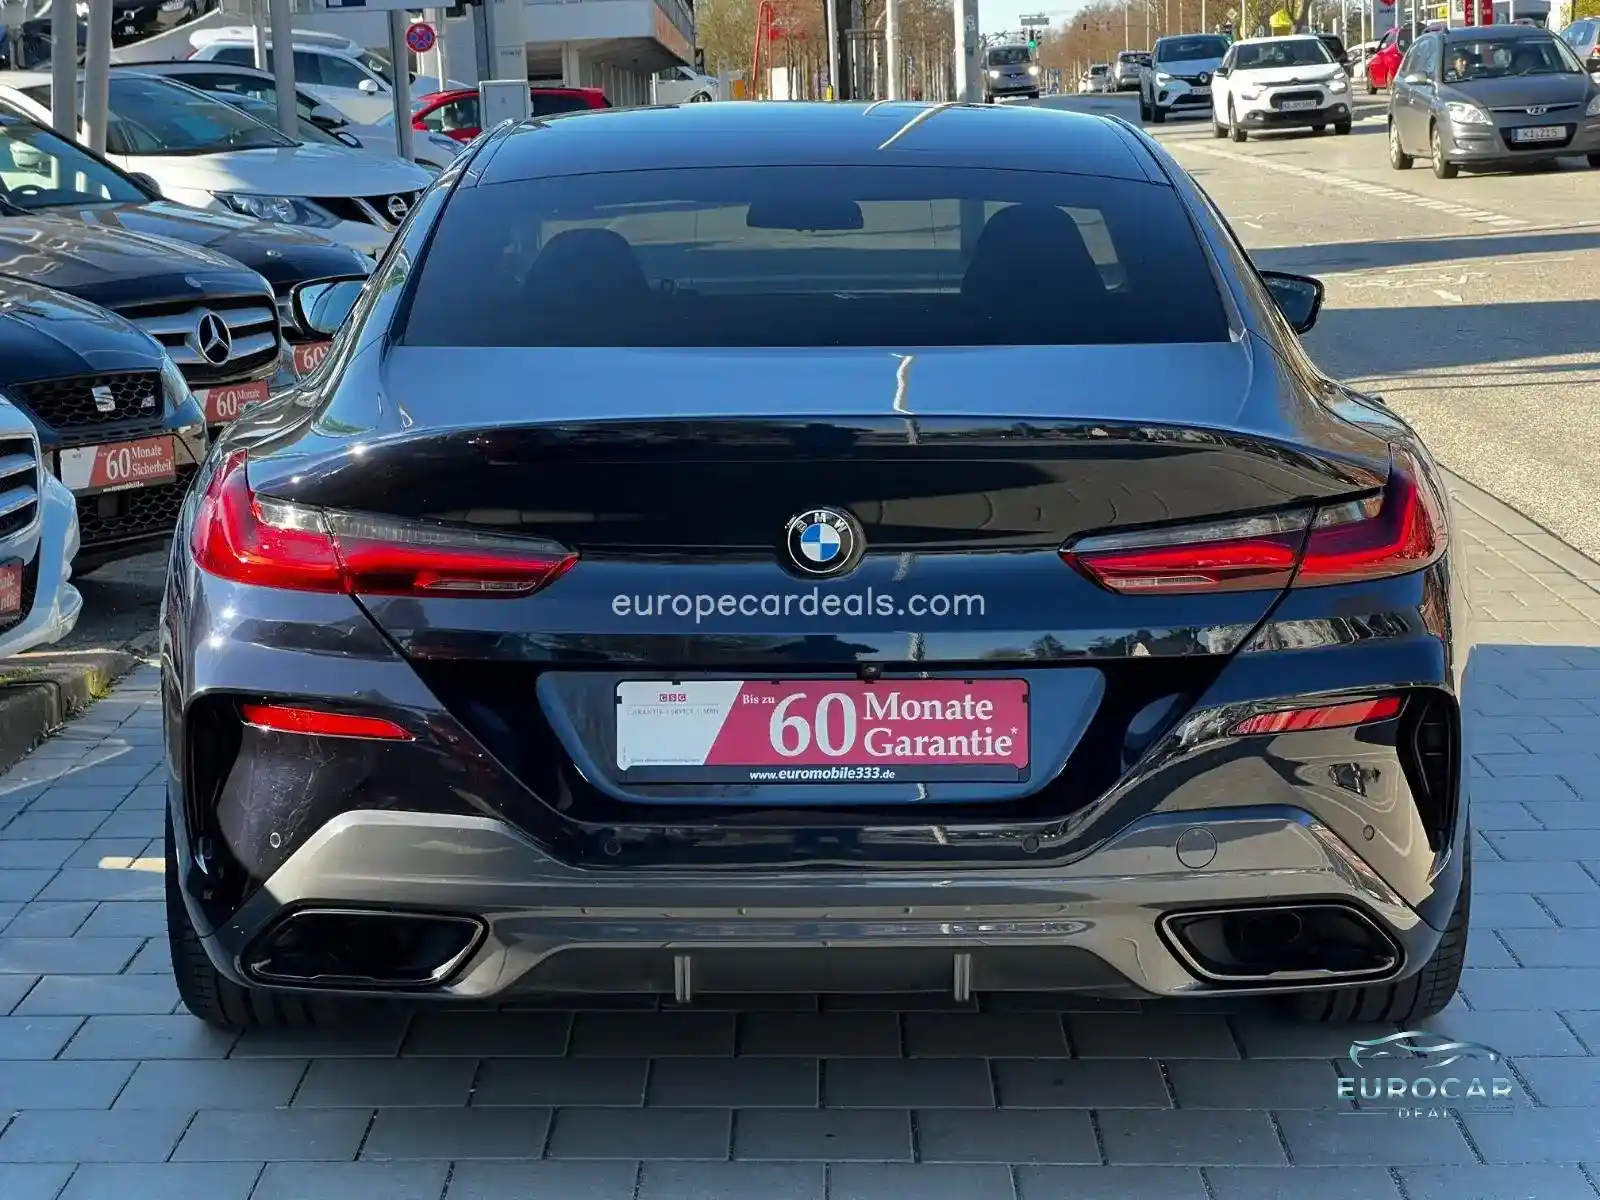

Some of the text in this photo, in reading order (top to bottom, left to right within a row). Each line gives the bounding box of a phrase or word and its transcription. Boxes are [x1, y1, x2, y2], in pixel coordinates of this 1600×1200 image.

[216, 389, 237, 417] 60
[106, 444, 162, 480] 60 Monate
[796, 512, 848, 532] BMW
[743, 695, 759, 704] Bis
[770, 692, 857, 758] 60
[863, 692, 993, 721] Monate
[749, 767, 895, 781] www.euromobile333.de
